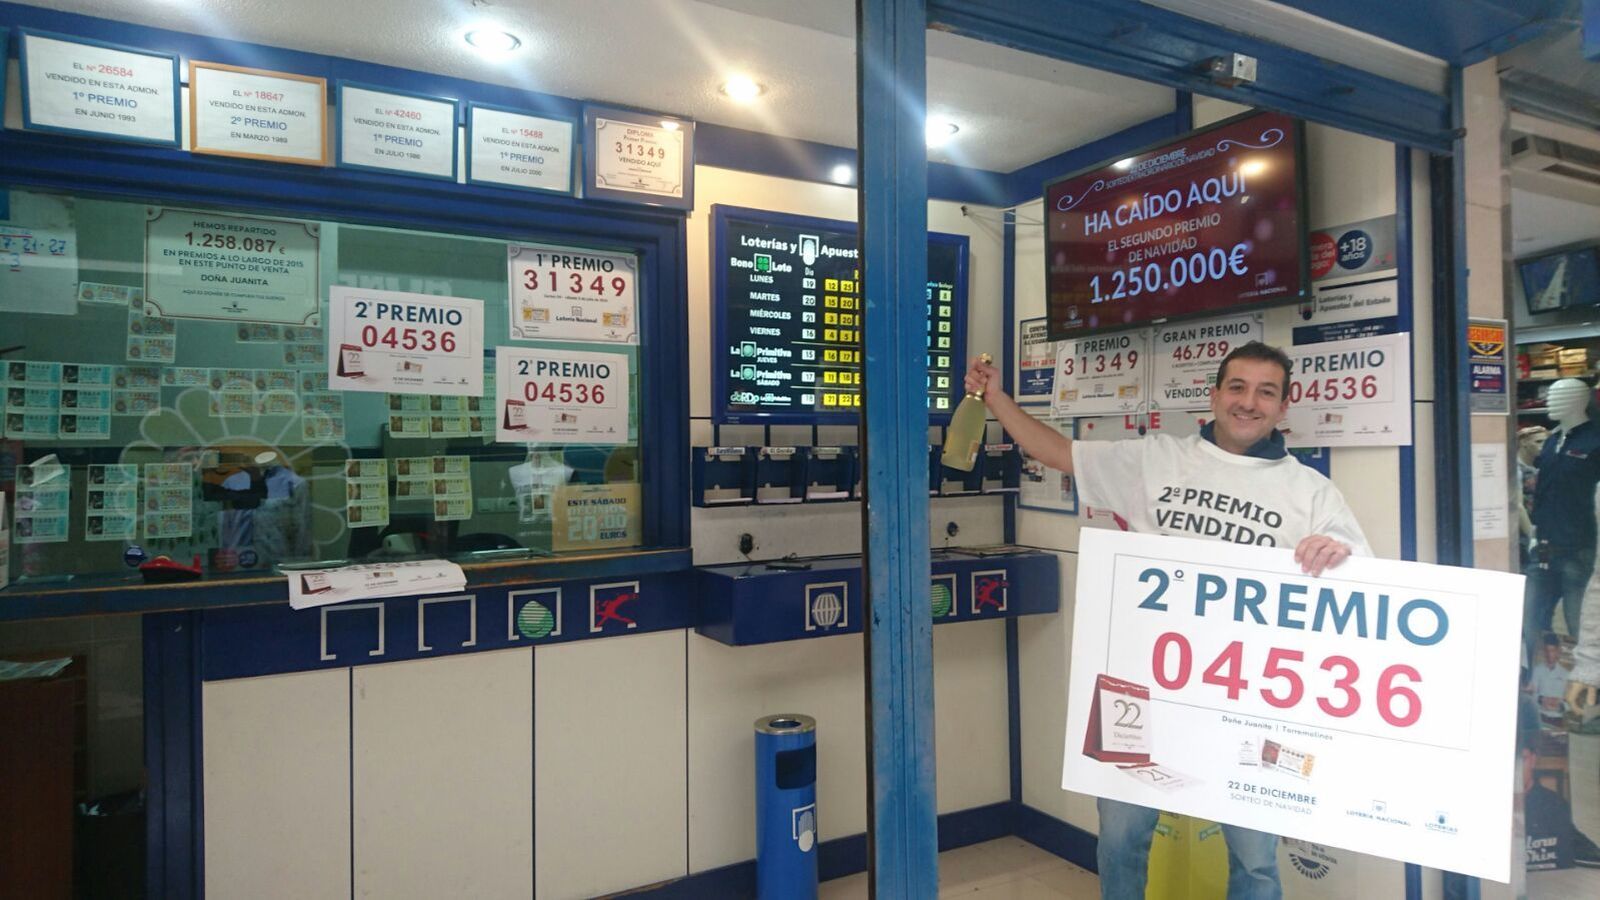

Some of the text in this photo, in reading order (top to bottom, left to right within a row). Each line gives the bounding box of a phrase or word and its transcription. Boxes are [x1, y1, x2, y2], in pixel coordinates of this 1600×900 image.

[73, 62, 83, 70] EL
[98, 64, 133, 78] 26584
[45, 72, 86, 85] VENDIDO
[89, 79, 100, 87] EN
[103, 81, 125, 90] ESTA
[88, 93, 138, 109] PREMIO
[255, 91, 284, 102] 18647
[209, 100, 243, 109] VENDIDO
[75, 108, 136, 122] EN JUNIO 1993
[394, 110, 421, 120] 42460
[244, 118, 288, 131] PREMIO
[354, 117, 384, 128] VENDIDO
[397, 124, 414, 132] ESTA
[243, 133, 269, 141] MARZO
[385, 135, 423, 148] PREMIO
[483, 137, 510, 145] VENDIDO
[520, 129, 543, 139] 15488
[510, 153, 544, 165] PREMIO
[619, 157, 645, 165] VENDIDO
[1148, 148, 1187, 169] DICIEMBRE
[1185, 148, 1216, 163] NAVIDAD
[1085, 208, 1112, 236] HA
[1115, 190, 1182, 227] CAÍDO
[193, 221, 276, 236] HEMOS REPARTIDO
[1108, 213, 1221, 252] EL SEGUNDO PREMIO
[741, 235, 859, 258] Loterías y Apuest
[1129, 237, 1197, 264] DE NAVIDAD
[1341, 237, 1366, 251] +18
[178, 251, 218, 261] PREMIOS
[242, 257, 271, 266] LARGO
[552, 255, 614, 272] PREMIO
[1342, 252, 1364, 261] años
[194, 260, 214, 268] ESTE
[216, 262, 246, 271] PUNTO
[262, 266, 289, 274] VENTA
[731, 257, 792, 273] Bono Loto
[201, 274, 268, 286] DOÑA JUANITA
[750, 274, 774, 283] LUNES
[1090, 244, 1249, 303] 1.250.000€
[750, 292, 780, 302] MARTES
[1320, 303, 1350, 312] Apuestas
[1366, 297, 1391, 306] Estado
[377, 303, 462, 326] PREMIO
[750, 308, 791, 319] MIÉRCOLES
[806, 314, 814, 322] 21
[362, 325, 456, 353] 04536
[750, 327, 780, 336] VIERNES
[1163, 323, 1250, 343] GRAN PREMIO
[1084, 336, 1130, 353] PREMIO
[1173, 341, 1229, 361] 46.789
[730, 346, 740, 355] La
[757, 347, 792, 357] Primitiva
[828, 352, 836, 360] 16
[1302, 350, 1384, 374] PREMIO
[537, 361, 610, 379] PREMIO
[730, 370, 740, 378] La
[757, 370, 792, 380] Primitiva
[1472, 365, 1502, 375] ALARMA
[525, 382, 605, 404] 04536
[1164, 387, 1211, 399] VENDIDO
[1290, 375, 1377, 403] 04536
[1158, 486, 1282, 529] 2º PREMIO
[1156, 509, 1276, 547] VENDIDO
[1137, 568, 1449, 646] 2º PREMIO
[1152, 631, 1423, 728] 04536
[1114, 699, 1143, 730] 22
[1222, 715, 1333, 740] Doña Juanita Torremolinos
[1228, 781, 1317, 805] 22 DE DICIEMBRE
[1230, 793, 1312, 815] SORTEO DE NAVIDAD
